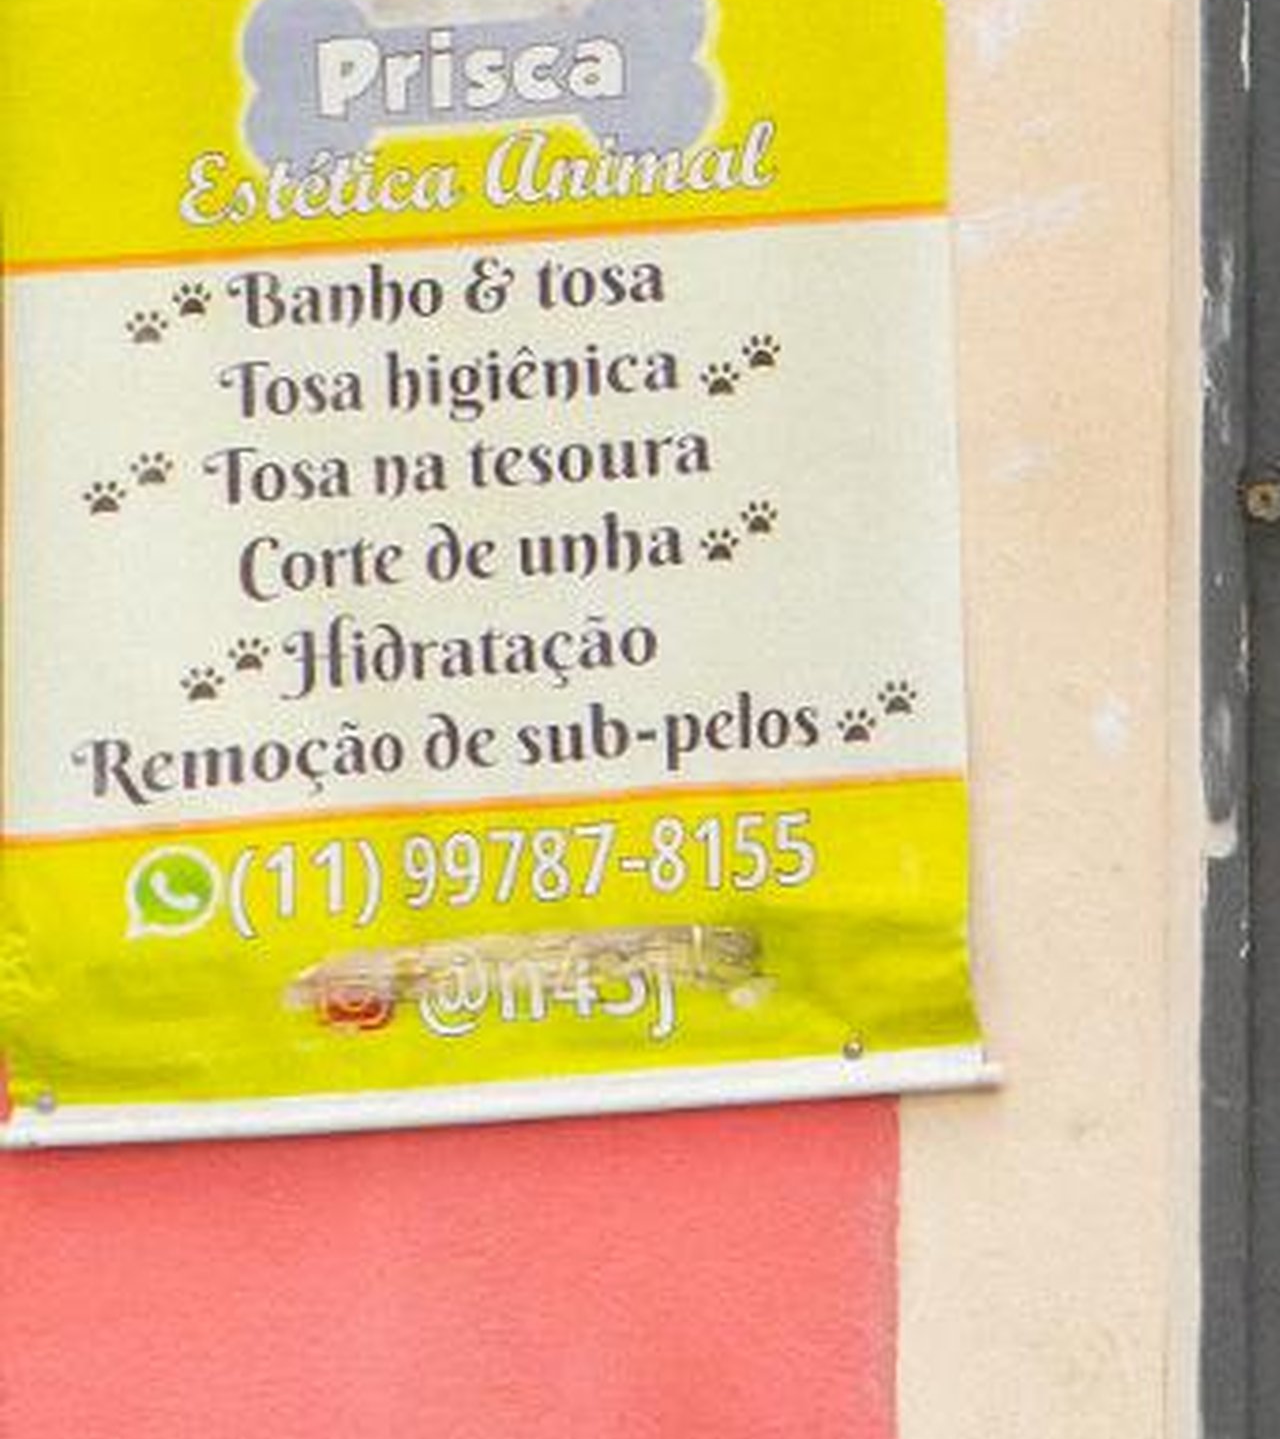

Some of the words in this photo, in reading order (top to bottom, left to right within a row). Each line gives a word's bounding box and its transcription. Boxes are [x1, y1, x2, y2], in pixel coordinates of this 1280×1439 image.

[315, 26, 627, 120] Prisca
[178, 144, 460, 227] Estética
[484, 121, 776, 205] Animal
[227, 262, 445, 329] Banho
[464, 255, 517, 313] &
[537, 253, 667, 309] tosa
[219, 358, 364, 421] Tosa
[387, 344, 679, 422] higiênica
[203, 444, 350, 507] Tosa
[373, 454, 447, 502] na
[470, 427, 712, 488] tesoura
[238, 534, 403, 602] Corte
[426, 522, 497, 581] de
[520, 513, 684, 577] unha
[281, 612, 659, 700] Hidratação
[72, 718, 403, 806] Remoção
[426, 710, 497, 771] de
[518, 690, 820, 771] sub-pelos
[228, 839, 382, 938] (11)
[404, 811, 818, 910] 99787-8155
